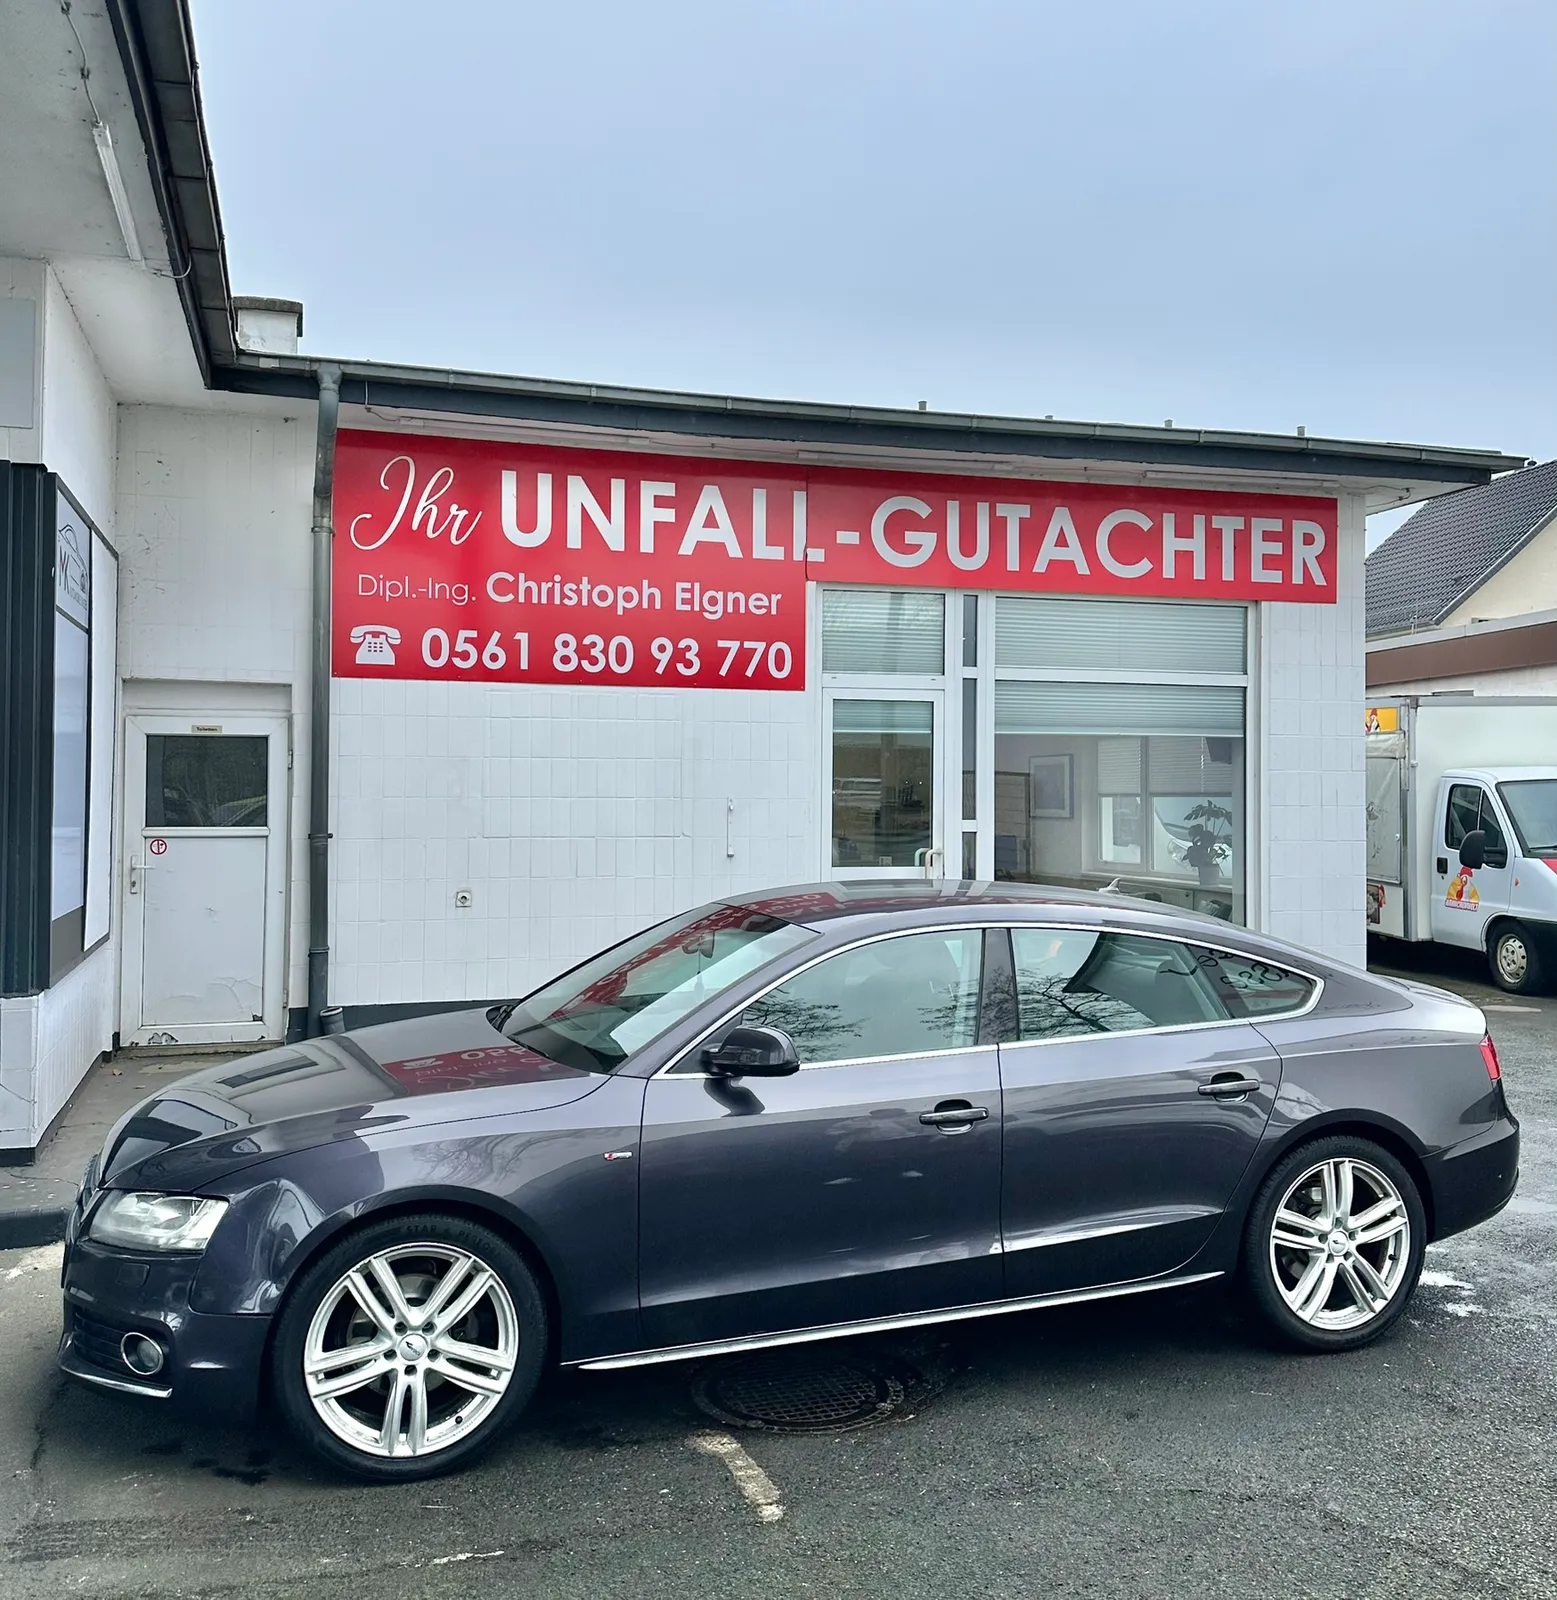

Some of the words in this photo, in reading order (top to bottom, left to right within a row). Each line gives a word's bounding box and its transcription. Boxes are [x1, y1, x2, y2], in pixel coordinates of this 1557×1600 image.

[350, 456, 482, 550] Ihr
[358, 573, 476, 605] Dipl.-Ing.
[487, 572, 661, 615] Christoph
[676, 582, 782, 619] Elgner
[422, 628, 528, 669] 0561
[553, 633, 633, 673] 830
[651, 637, 700, 675] 93
[718, 640, 792, 678] 770
